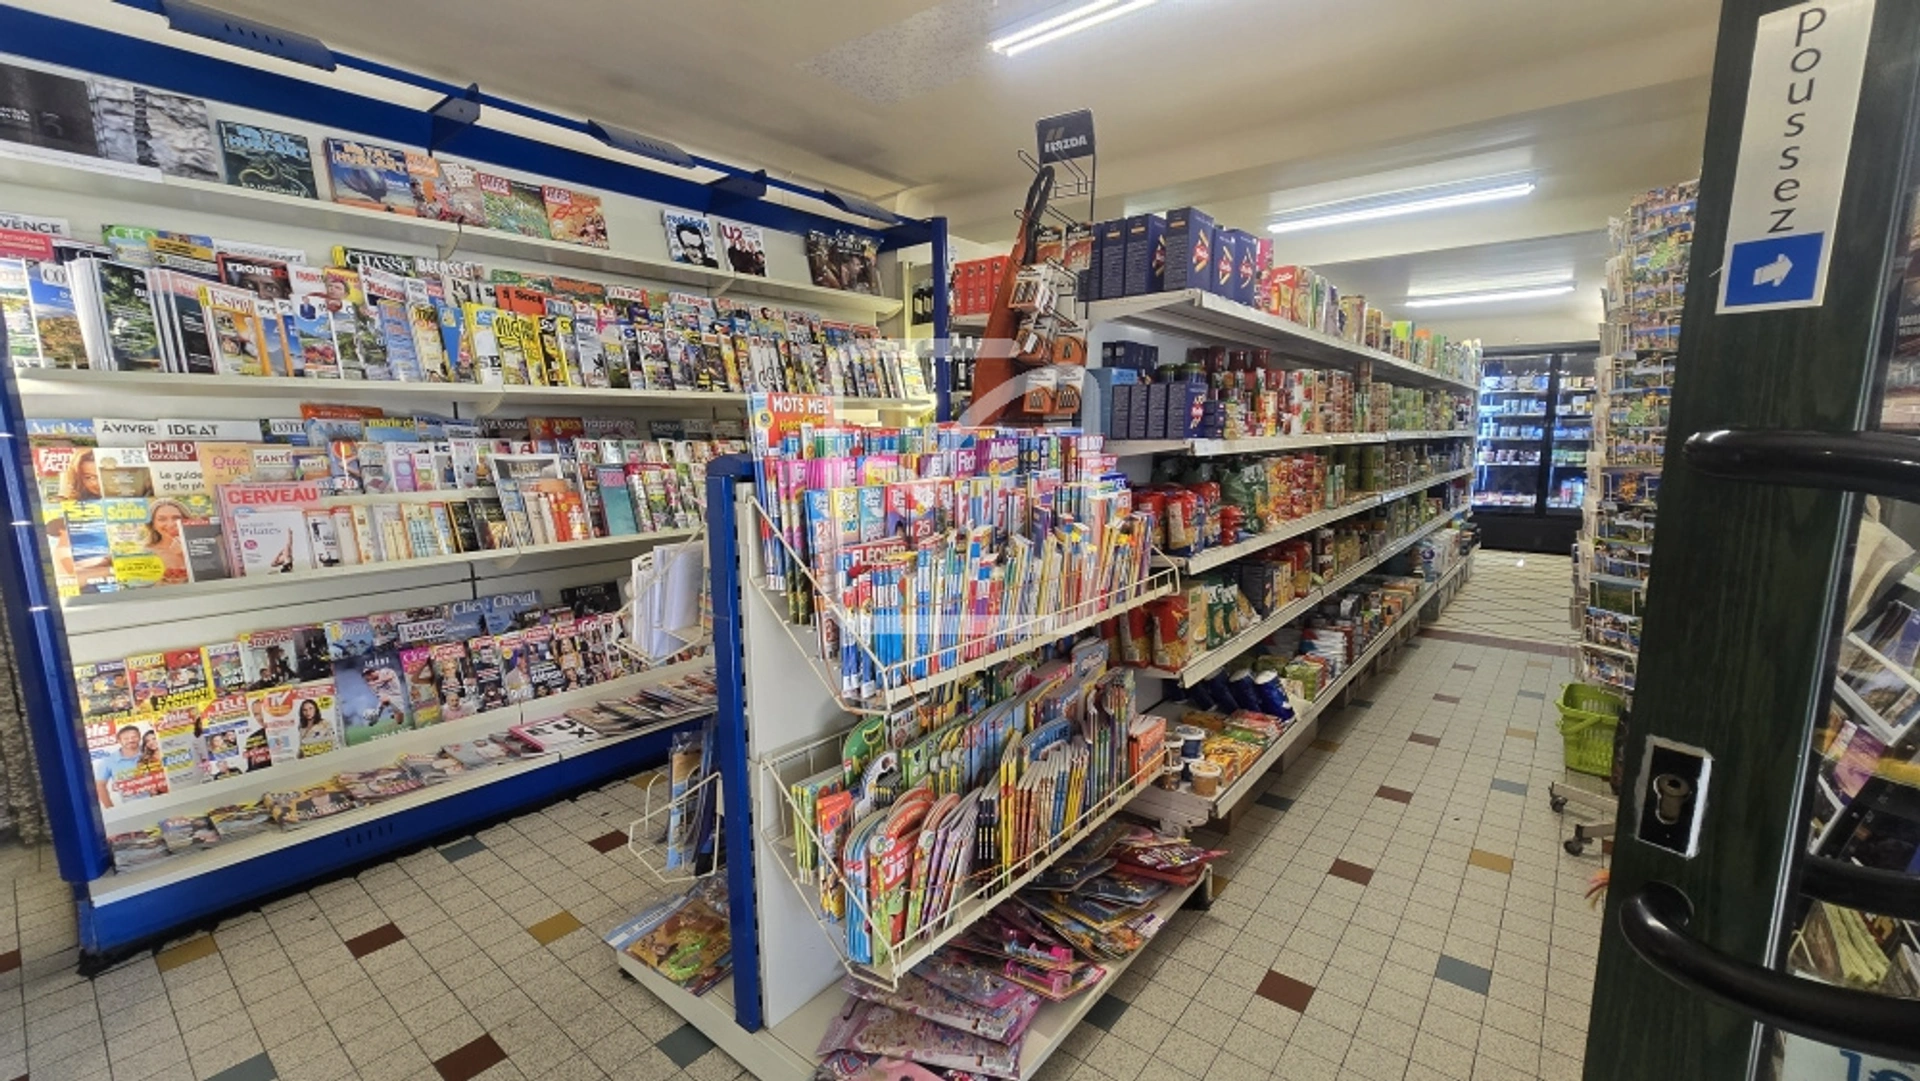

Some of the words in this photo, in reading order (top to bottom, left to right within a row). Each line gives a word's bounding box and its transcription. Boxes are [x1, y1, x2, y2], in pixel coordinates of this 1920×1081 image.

[772, 395, 804, 414] MOTS
[167, 423, 219, 436] IDEAT
[227, 487, 319, 505] CERVEAU
